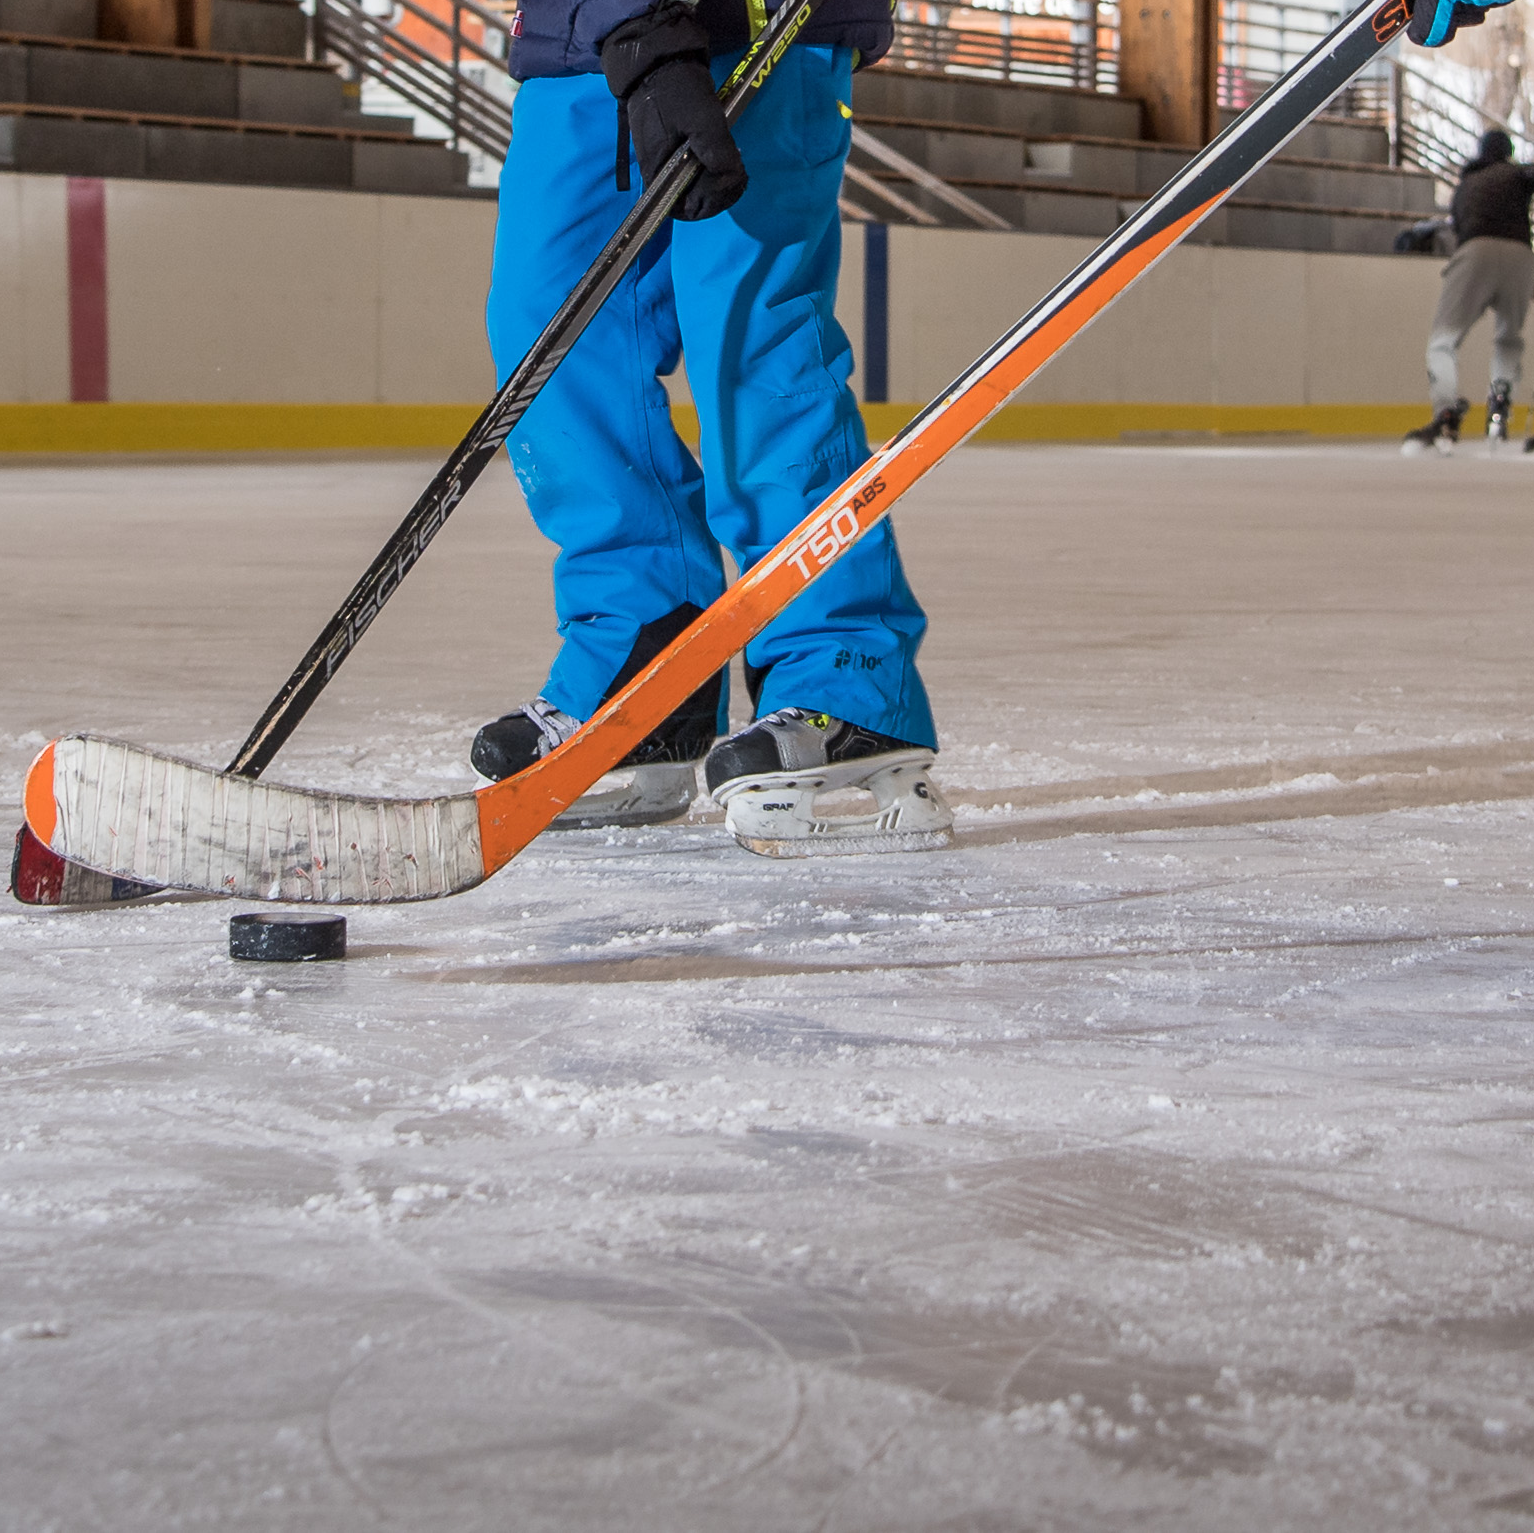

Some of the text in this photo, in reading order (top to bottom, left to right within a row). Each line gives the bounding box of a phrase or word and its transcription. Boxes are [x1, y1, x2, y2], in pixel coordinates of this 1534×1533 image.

[751, 3, 812, 89] W250
[787, 476, 887, 580] T50 ABS
[324, 479, 463, 680] FISCHER
[762, 802, 795, 812] GRAF
